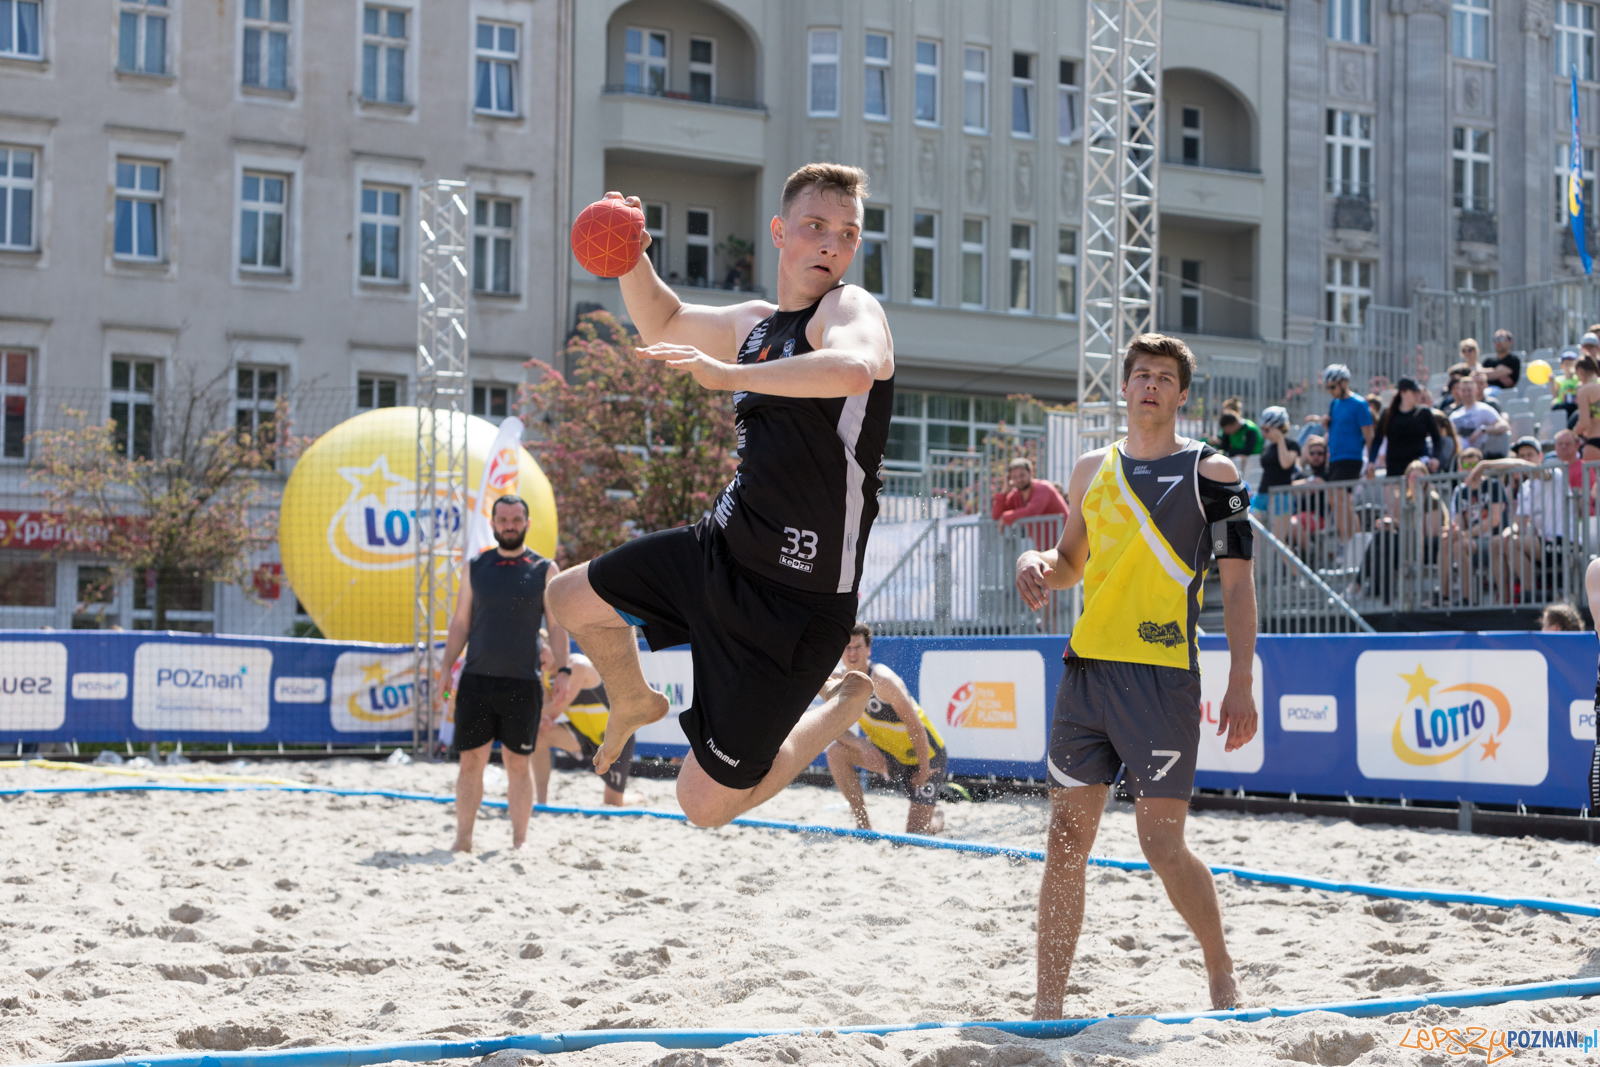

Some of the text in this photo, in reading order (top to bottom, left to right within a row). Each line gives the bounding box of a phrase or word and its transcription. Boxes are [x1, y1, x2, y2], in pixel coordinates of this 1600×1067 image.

[1156, 475, 1184, 505] 7
[781, 526, 819, 560] 33
[1415, 699, 1485, 748] LOTTO
[706, 737, 740, 768] hummel
[1151, 749, 1182, 781] 7
